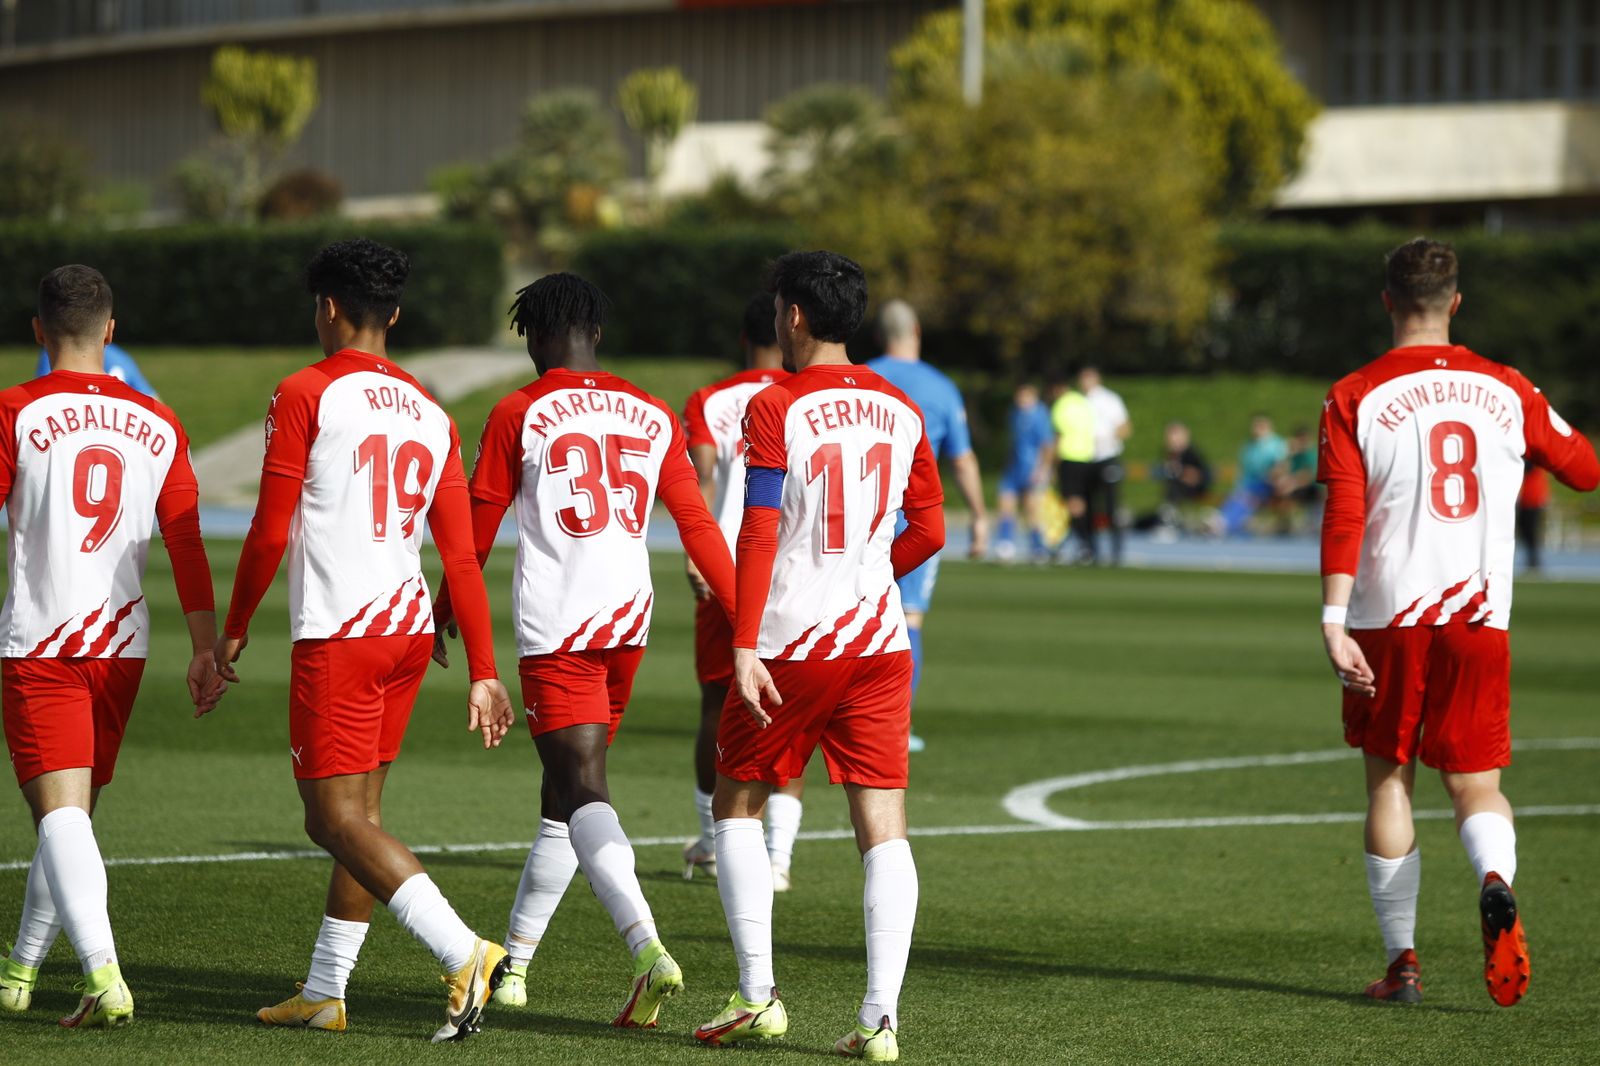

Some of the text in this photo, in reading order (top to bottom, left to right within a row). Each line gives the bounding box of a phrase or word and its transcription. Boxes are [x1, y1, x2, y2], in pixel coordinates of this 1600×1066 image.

[28, 404, 167, 457] CABALLERO
[363, 386, 422, 422] ROJAS
[528, 391, 662, 440] MARCIANO
[804, 398, 896, 438] FERMIN
[1376, 381, 1513, 435] KEVIN BAUTISTA
[72, 444, 126, 553] 9
[353, 434, 434, 543] 19
[545, 432, 651, 539] 35
[805, 442, 893, 555] 11
[1425, 420, 1480, 523] 8
